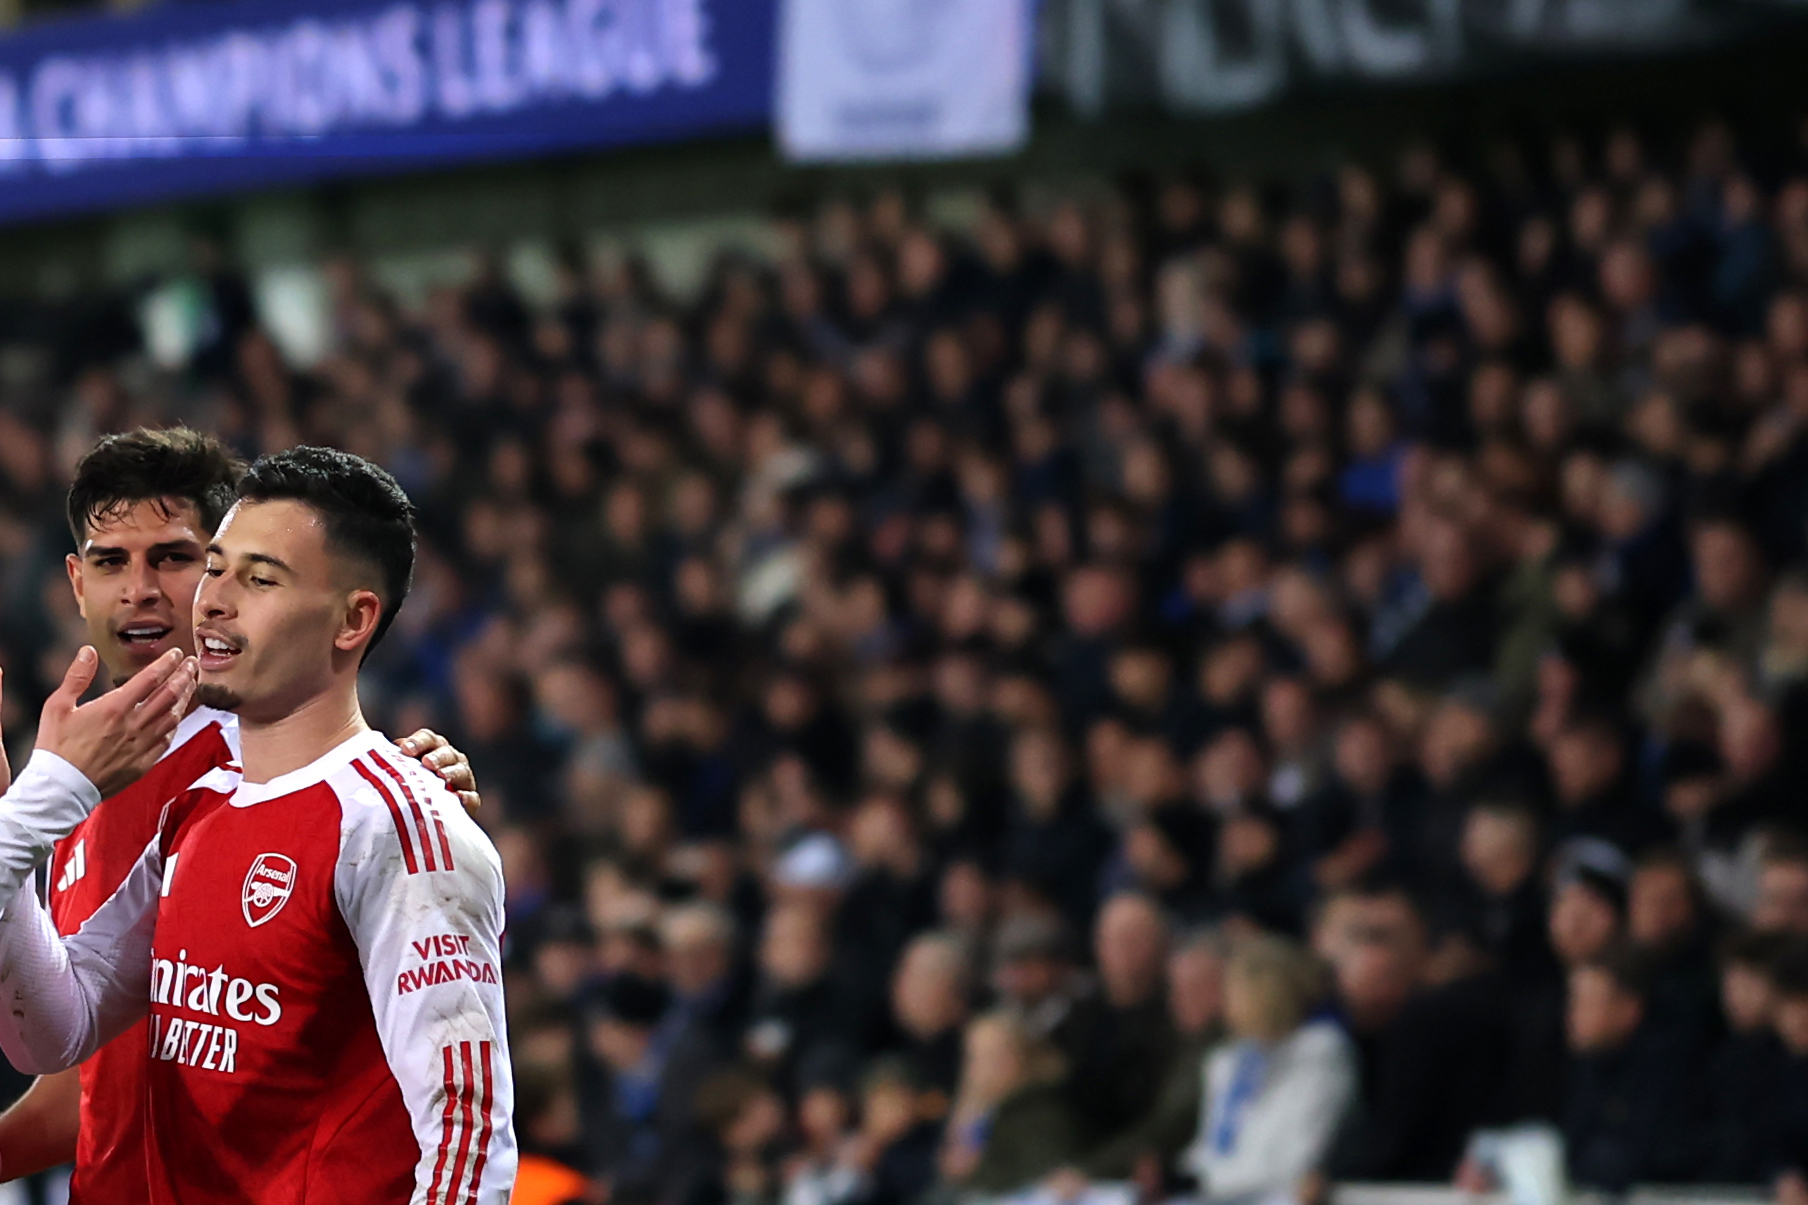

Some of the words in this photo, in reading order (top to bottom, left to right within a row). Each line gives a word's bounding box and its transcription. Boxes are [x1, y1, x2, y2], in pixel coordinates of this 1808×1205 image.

[30, 6, 424, 178] CHAMPIONS
[430, 0, 718, 116] LEAGUE
[256, 863, 291, 884] Arsenal
[411, 934, 470, 961] VISIT
[149, 947, 282, 1027] mirates
[397, 958, 498, 996] RWANDA
